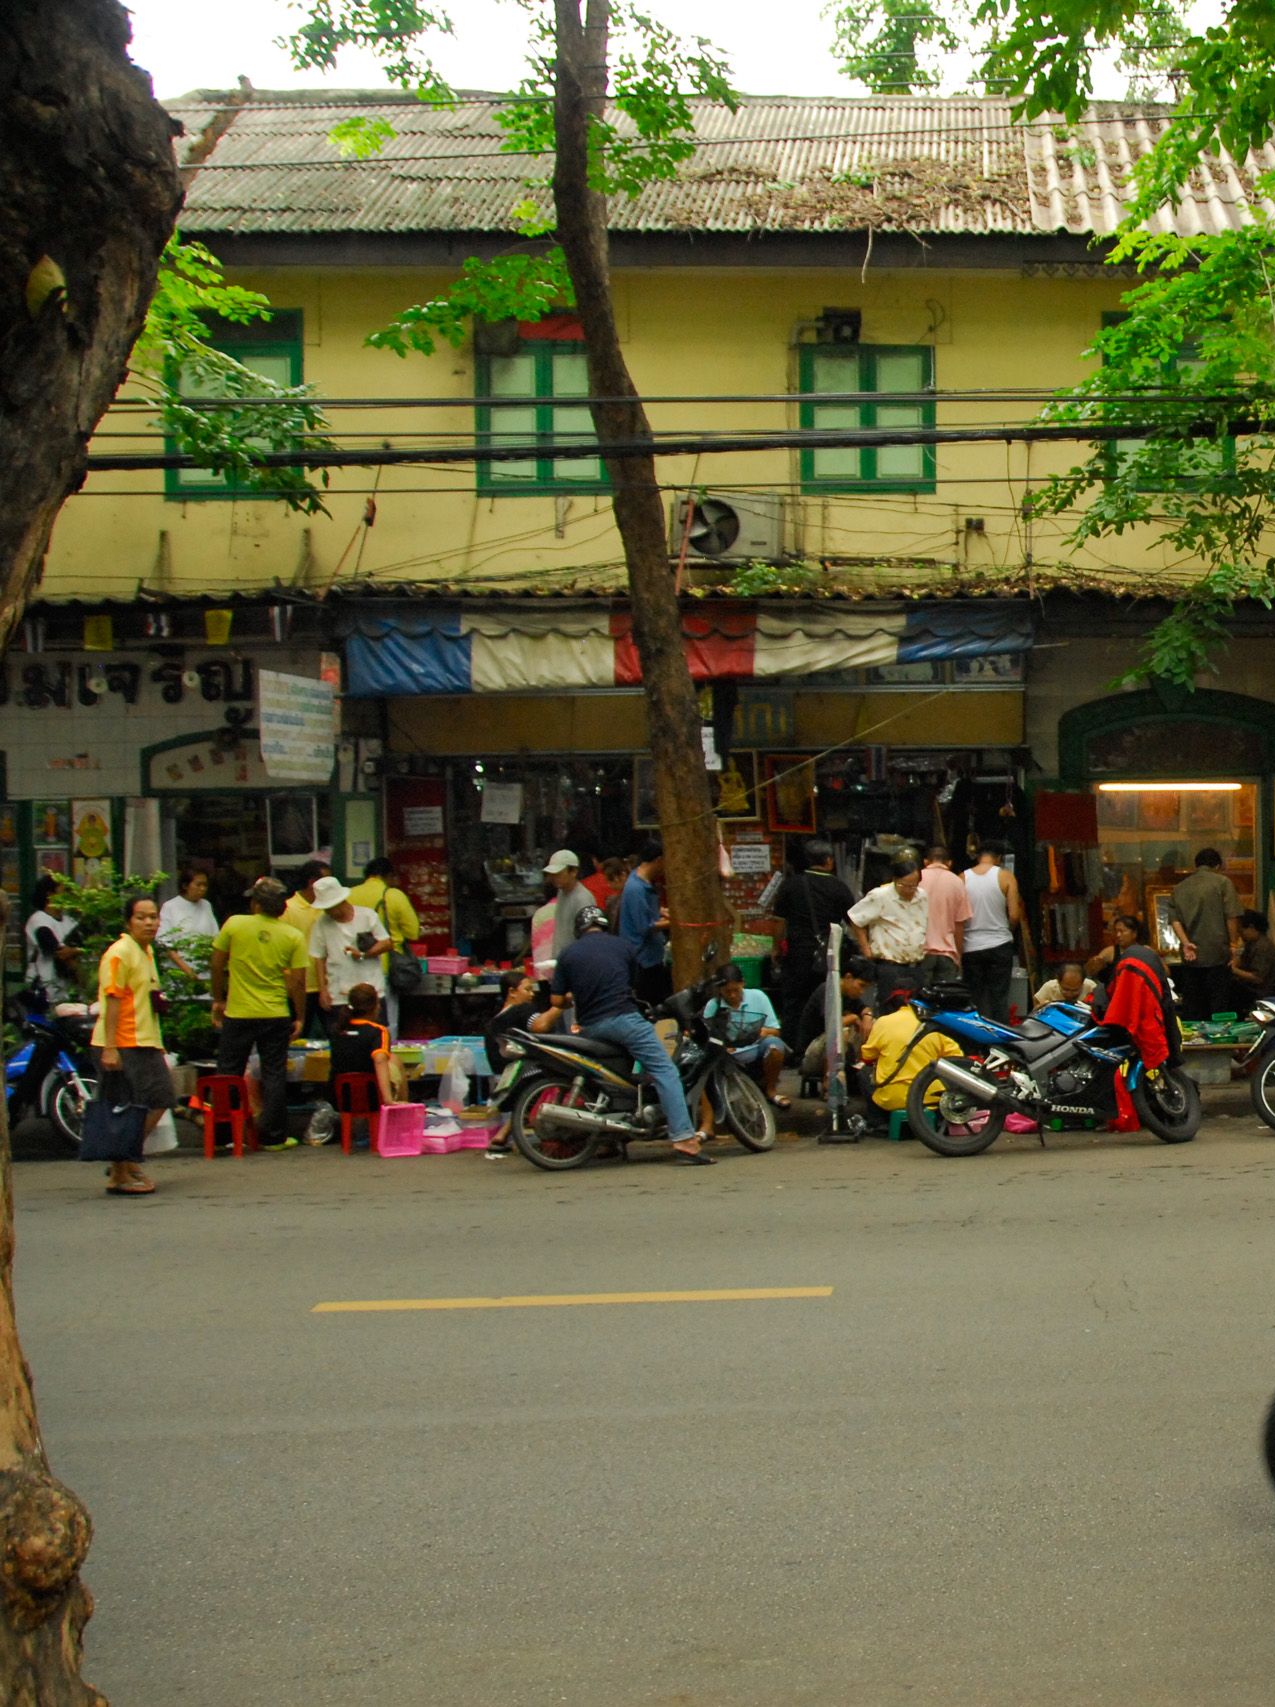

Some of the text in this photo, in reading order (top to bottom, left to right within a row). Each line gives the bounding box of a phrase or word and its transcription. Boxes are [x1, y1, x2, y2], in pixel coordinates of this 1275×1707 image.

[0, 644, 254, 724] มเจริญ
[1051, 1104, 1095, 1115] HONDA
